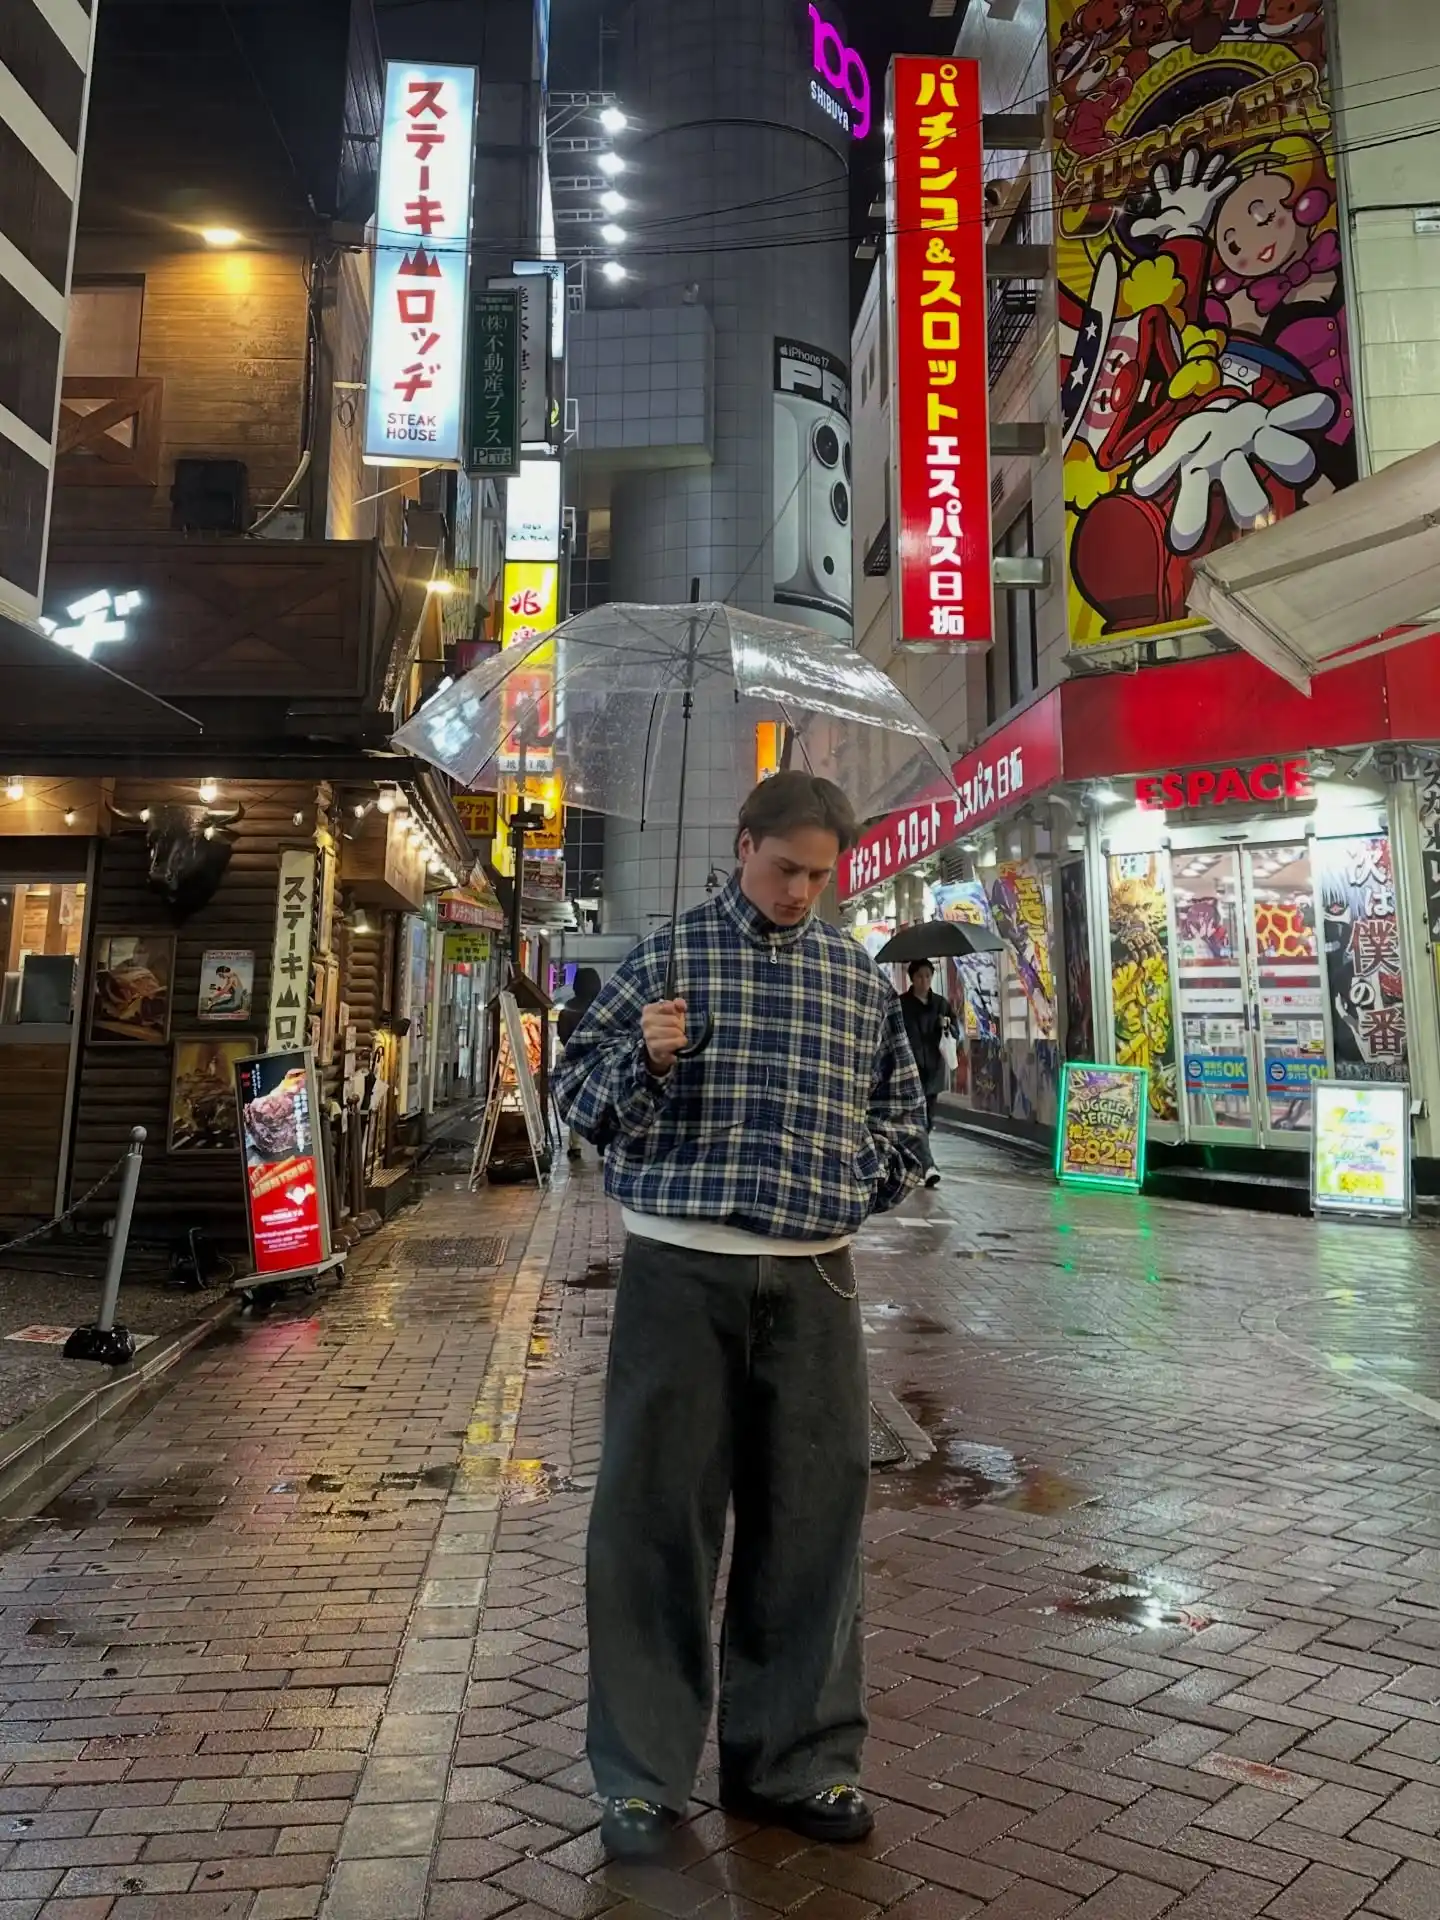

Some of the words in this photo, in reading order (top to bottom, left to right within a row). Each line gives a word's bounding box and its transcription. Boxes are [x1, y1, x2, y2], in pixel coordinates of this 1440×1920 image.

[810, 79, 849, 131] SHIBUYA
[788, 345, 821, 364] iPhone
[821, 355, 830, 369] 17
[386, 426, 437, 442] HOUSE
[387, 412, 436, 427] STEAK
[1135, 759, 1313, 811] ESPACE
[897, 802, 941, 864] スロット
[1349, 850, 1408, 1057] 次は僕の番
[1224, 1061, 1245, 1077] OK
